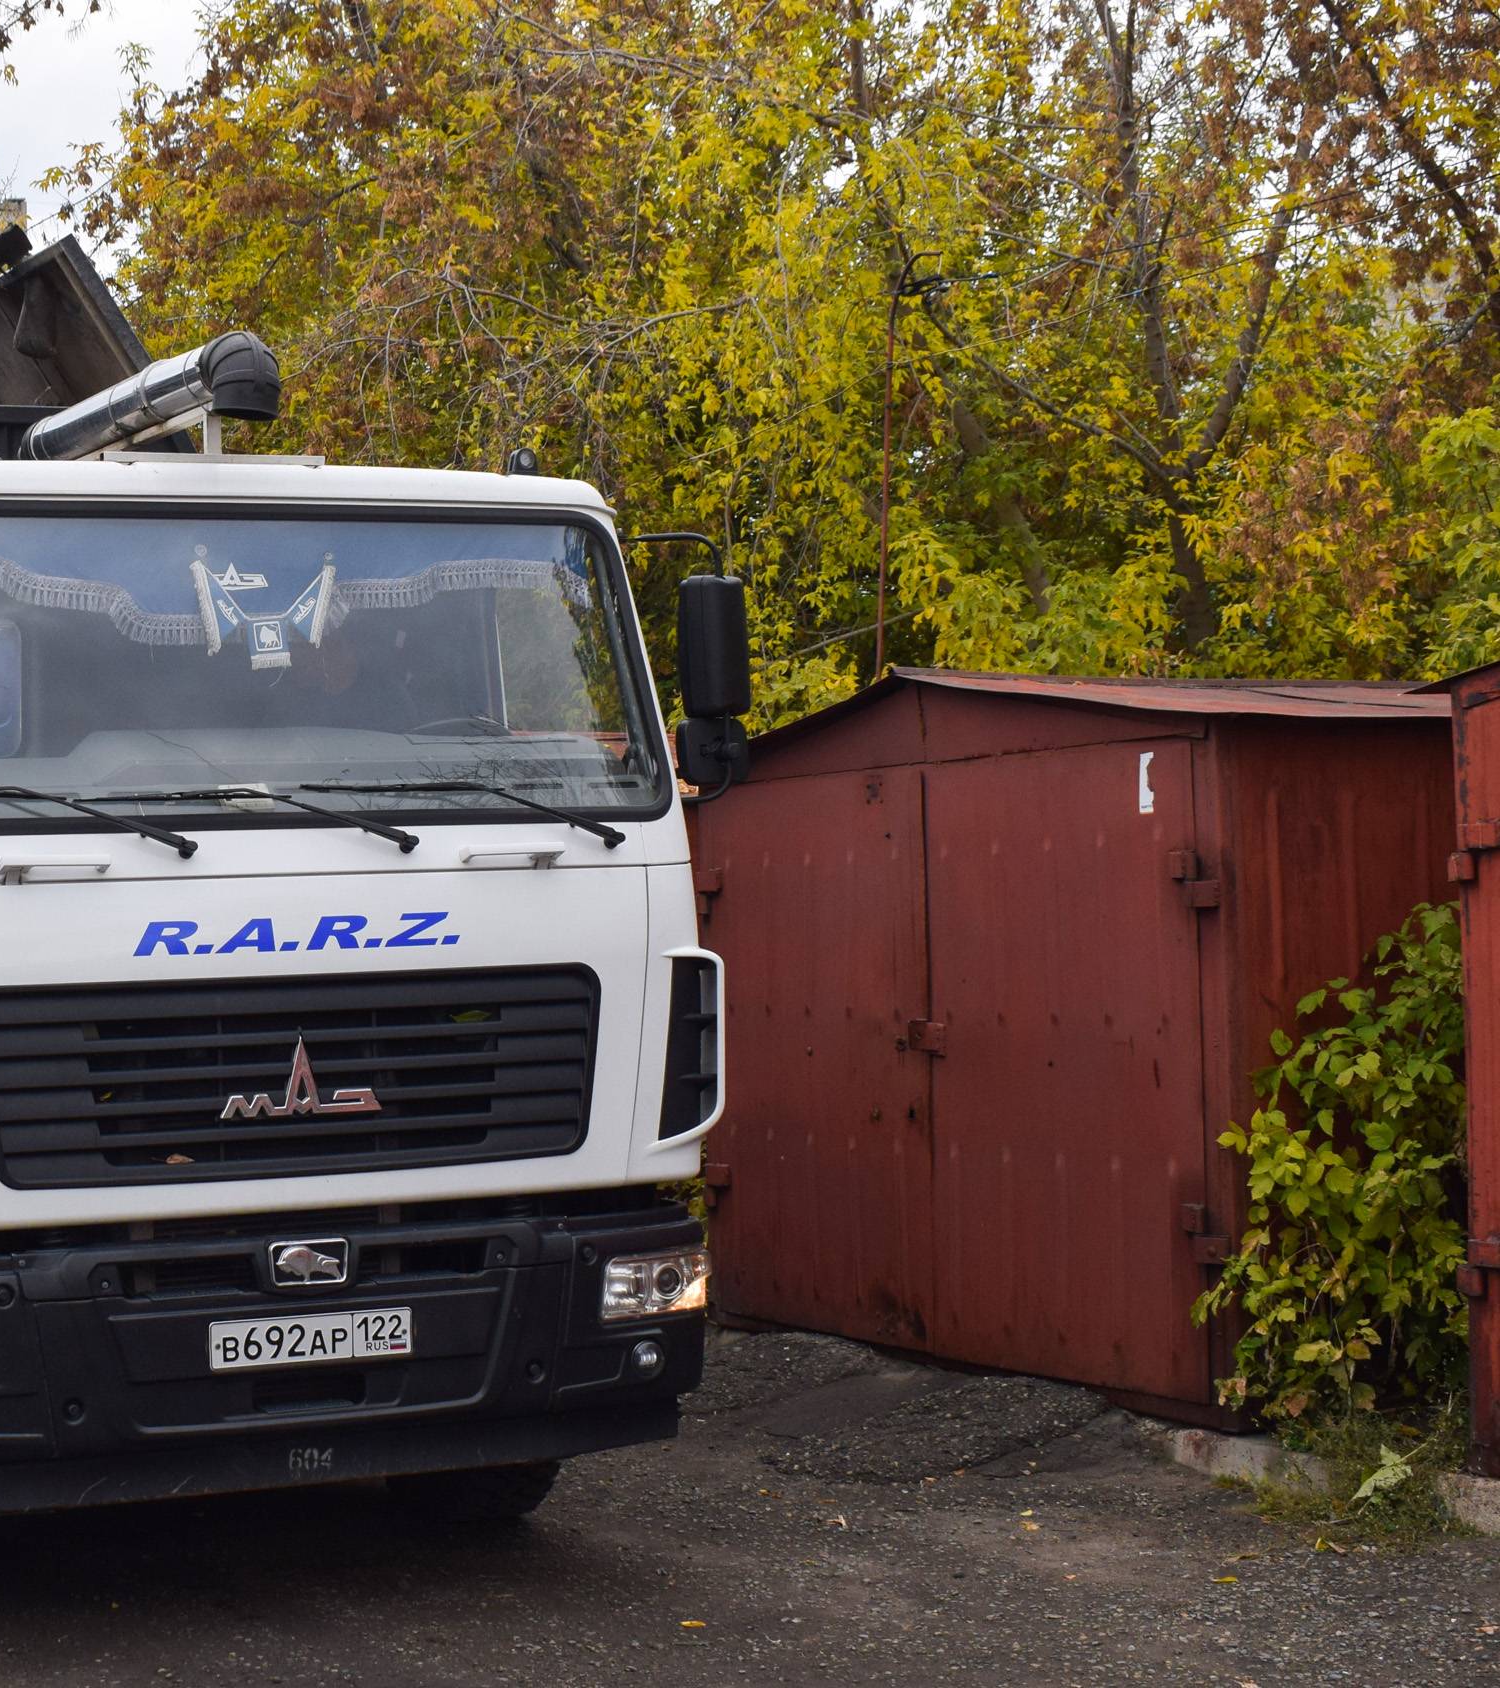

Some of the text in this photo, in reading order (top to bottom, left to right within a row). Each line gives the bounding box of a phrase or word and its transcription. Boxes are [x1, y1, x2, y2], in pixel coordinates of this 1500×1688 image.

[133, 911, 461, 957] R.A.R.Z.
[221, 1314, 402, 1363] В692АР 122
[365, 1340, 389, 1352] RUS
[289, 1448, 332, 1470] 604
